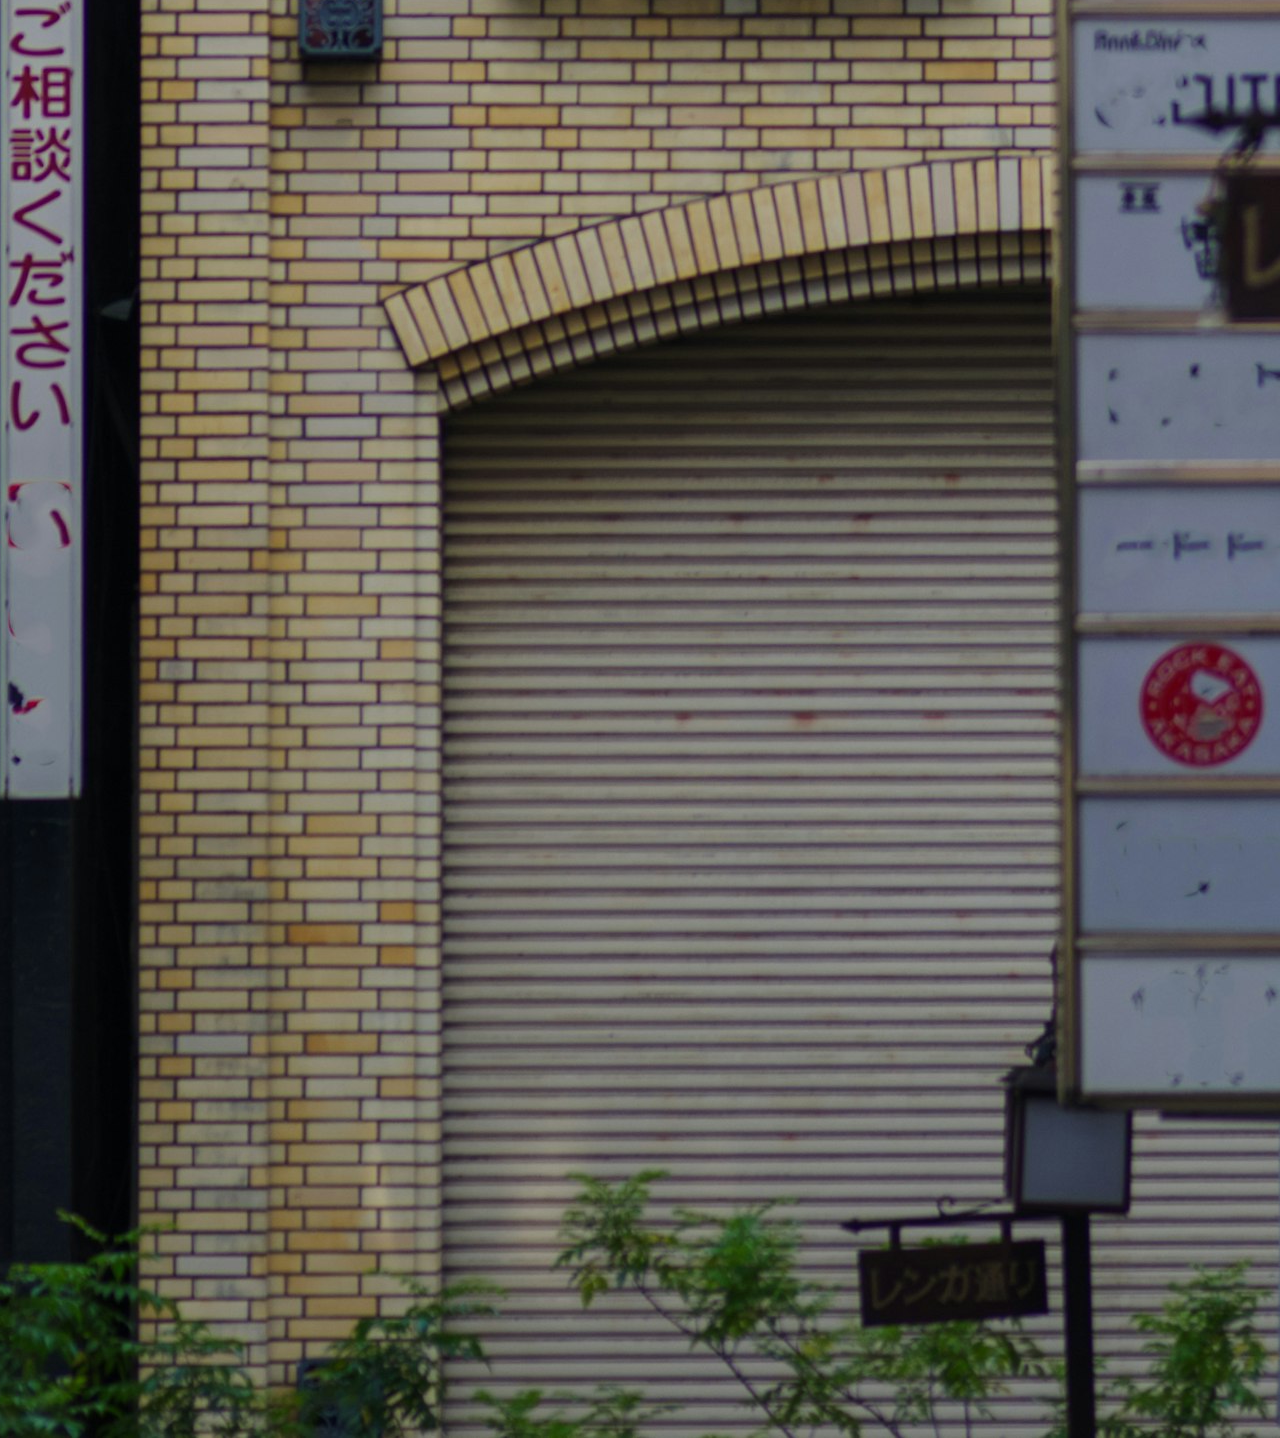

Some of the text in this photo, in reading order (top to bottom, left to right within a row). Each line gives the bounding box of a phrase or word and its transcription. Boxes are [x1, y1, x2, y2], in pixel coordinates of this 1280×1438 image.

[867, 1257, 1039, 1311] レンガ通り
